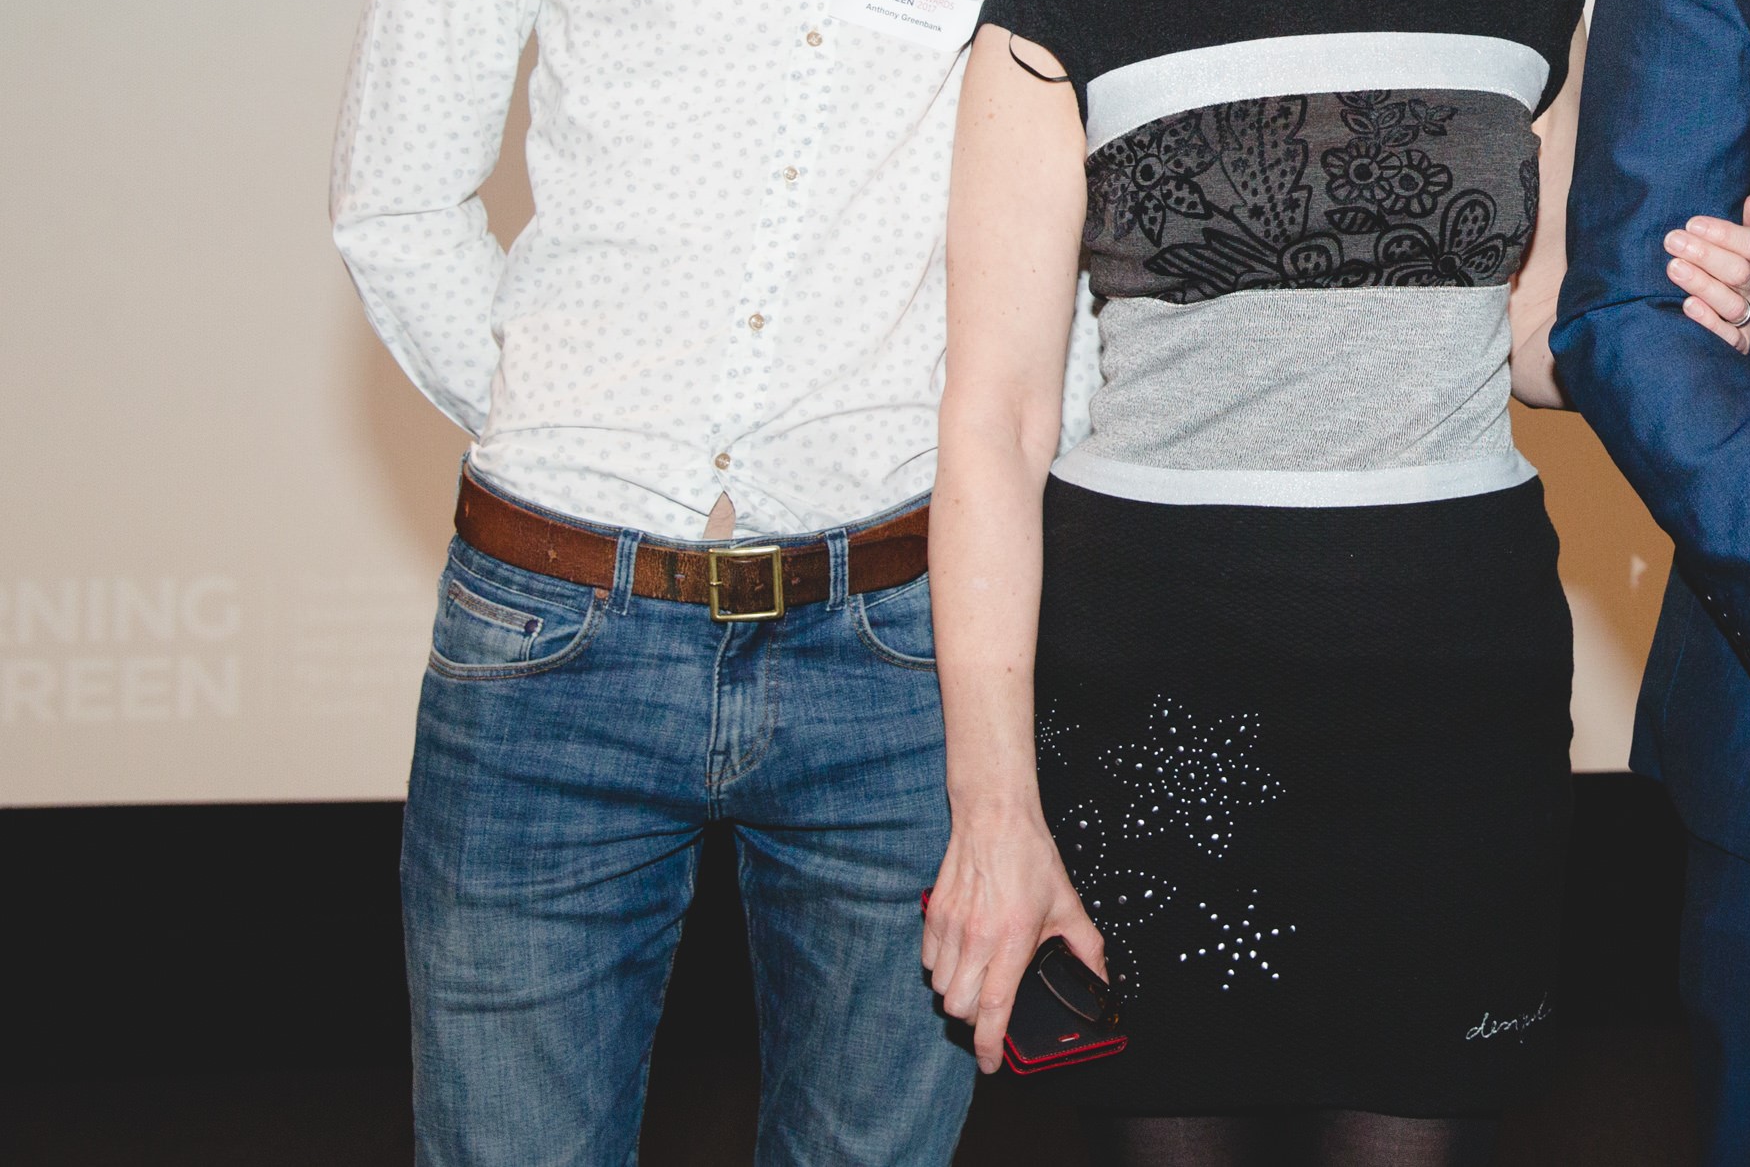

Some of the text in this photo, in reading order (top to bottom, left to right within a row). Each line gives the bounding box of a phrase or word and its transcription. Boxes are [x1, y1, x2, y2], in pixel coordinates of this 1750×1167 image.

[866, 3, 942, 32] Anthony Greenbank
[0, 575, 242, 642] NING
